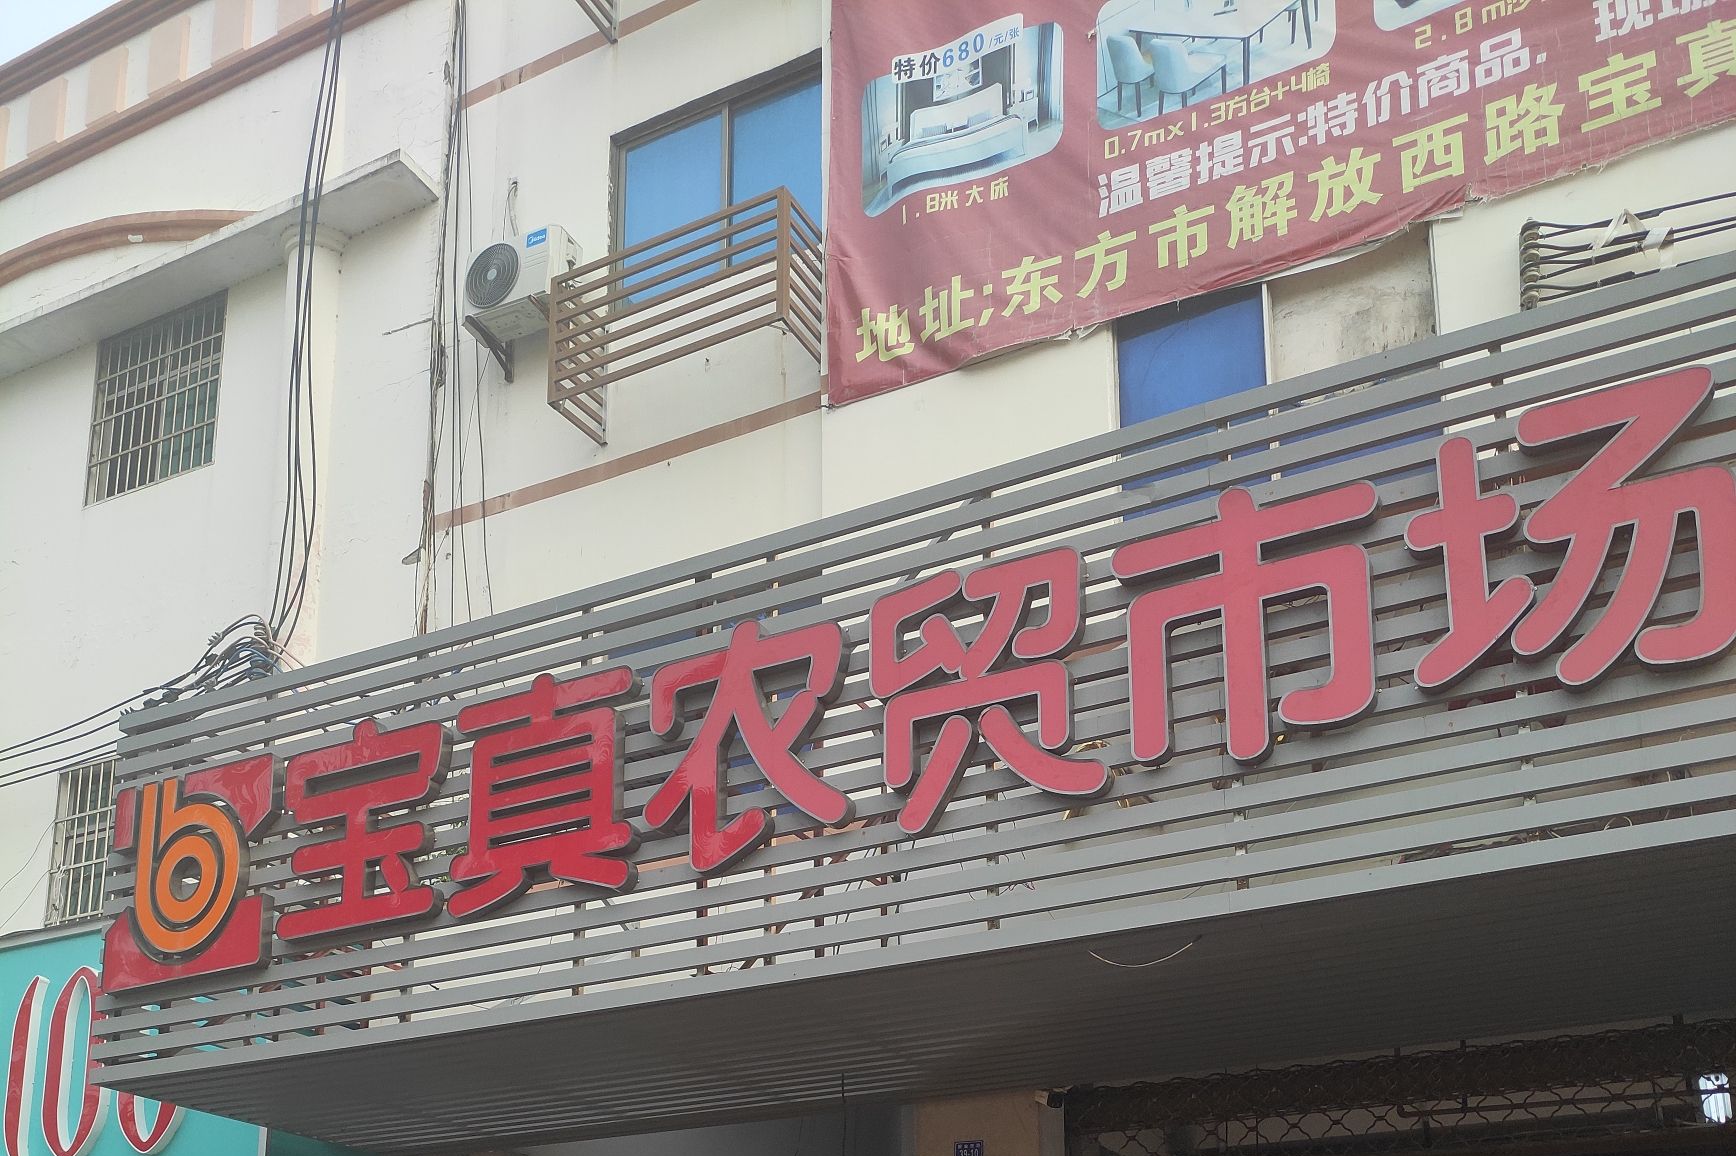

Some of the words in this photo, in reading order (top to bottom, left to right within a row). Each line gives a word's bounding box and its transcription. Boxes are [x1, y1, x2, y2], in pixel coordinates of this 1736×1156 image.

[275, 366, 1736, 944] 宝真农贸市场
